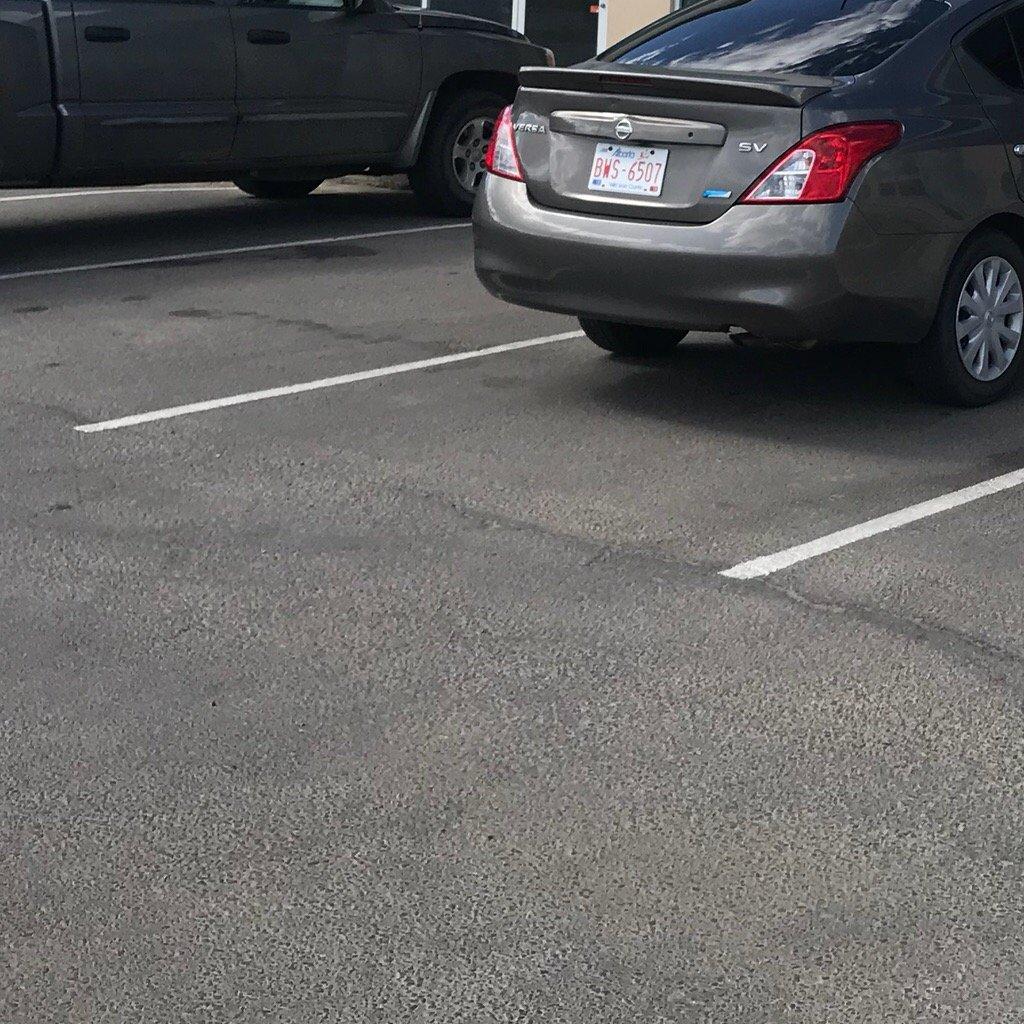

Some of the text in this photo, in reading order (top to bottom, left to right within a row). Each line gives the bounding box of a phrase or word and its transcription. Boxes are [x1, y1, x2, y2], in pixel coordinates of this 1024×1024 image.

[513, 123, 546, 134] VERSA
[738, 142, 768, 154] SV
[594, 157, 662, 183] BWS-6507
